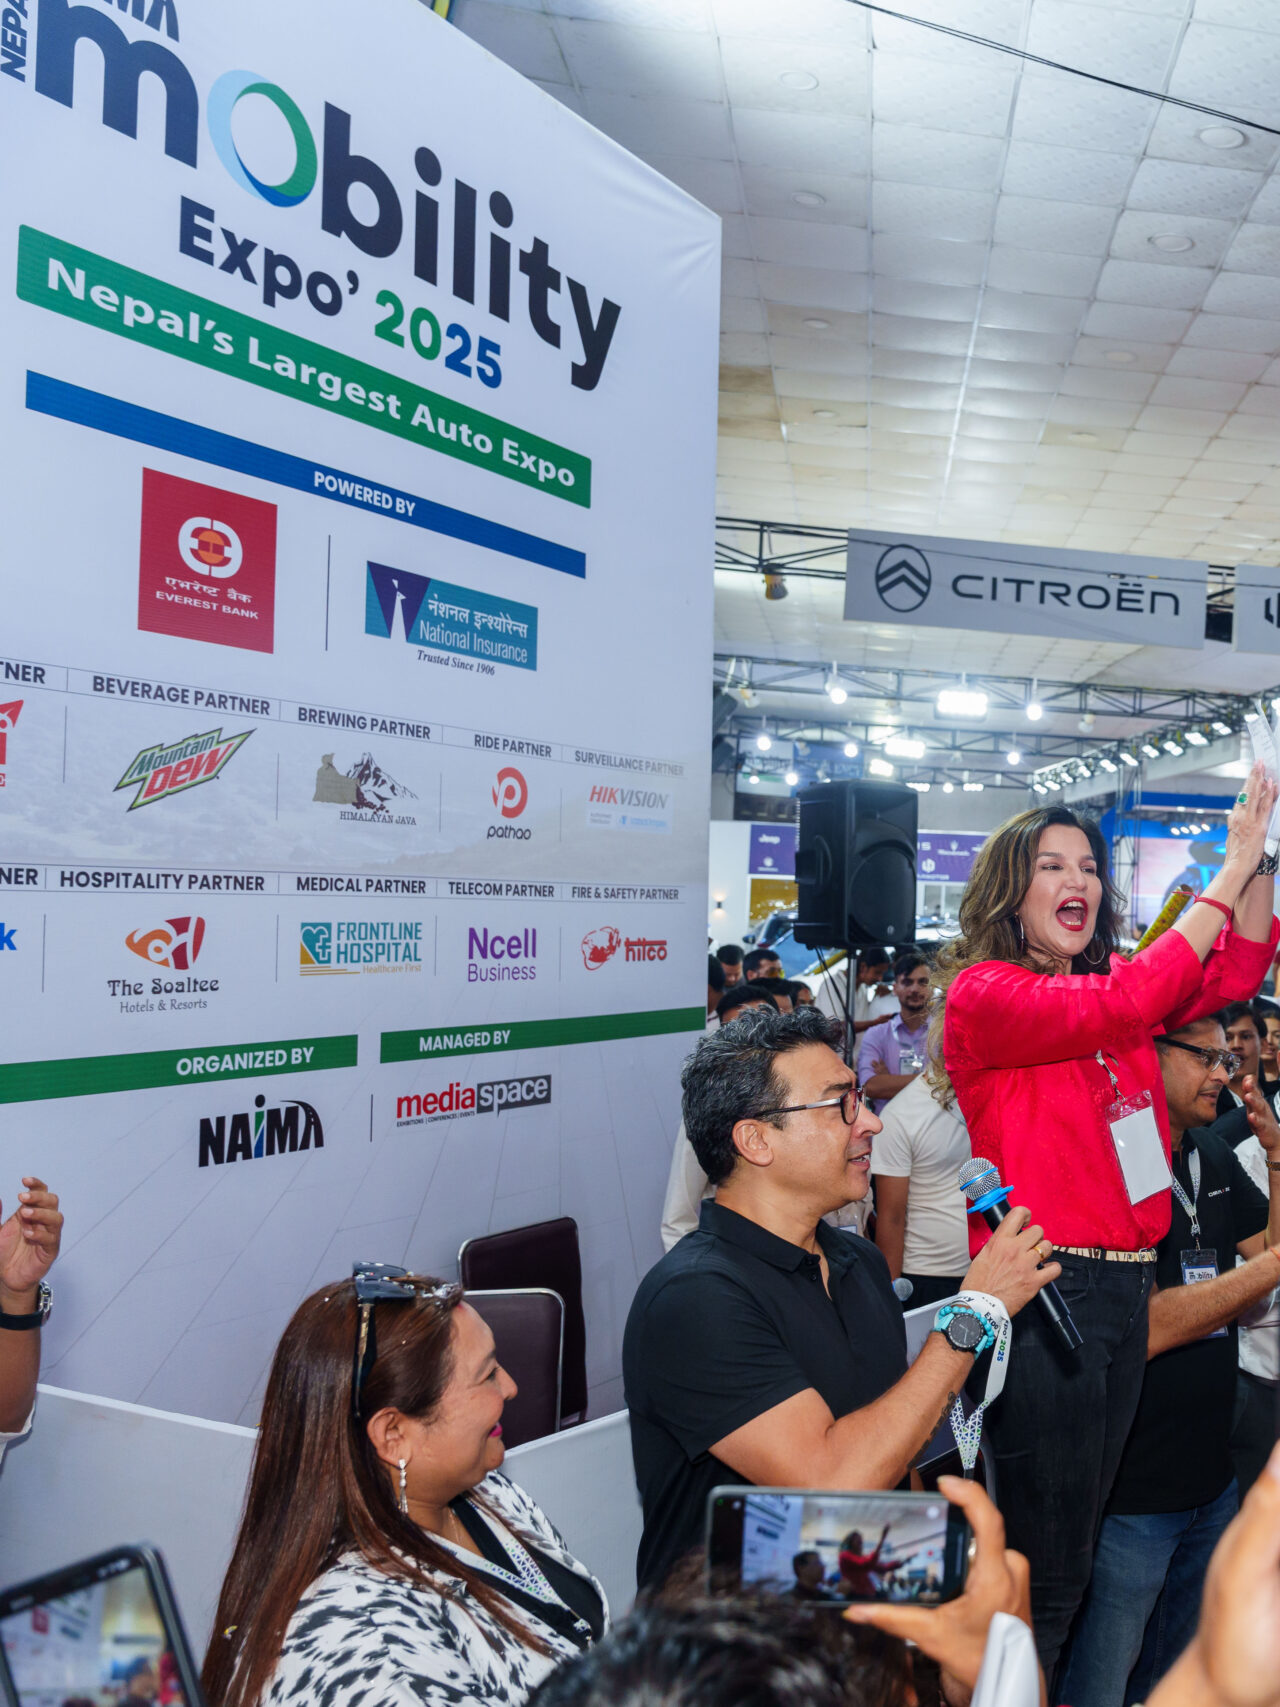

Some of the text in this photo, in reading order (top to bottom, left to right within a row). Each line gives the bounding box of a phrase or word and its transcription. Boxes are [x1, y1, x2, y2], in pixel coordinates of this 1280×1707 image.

[35, 0, 621, 391] mobility
[375, 290, 502, 388] 2025
[248, 336, 401, 420] Largest
[410, 403, 493, 454] Auto
[502, 441, 576, 488] Expo
[313, 471, 416, 517] POWERED BY
[156, 591, 259, 619] EVEREST BANK
[951, 573, 1180, 616] CITROËN
[420, 620, 528, 664] National Insurance
[417, 649, 496, 676] Trusted Since 1906
[93, 675, 270, 715] BEVERAGE PARTNER
[298, 707, 431, 741] BREWING PARTNER
[128, 735, 215, 779] Mountain
[474, 733, 552, 758] RIDE PARTNER
[575, 750, 684, 776] SURVEILLANCE PARTNER
[588, 785, 670, 809] HIKVISION
[339, 811, 417, 826] HIMALAYAN JAVA
[486, 825, 532, 840] pathao
[60, 871, 265, 891] HOSPITALITY PARTNER
[297, 876, 426, 894] MEDICAL PARTNER
[448, 882, 555, 898] TELECOM PARTNER
[572, 886, 679, 900] FIRE & SAFETY PARTNER
[336, 922, 423, 941] FRONTLINE
[468, 927, 537, 960] Ncell
[336, 942, 422, 964] HOSPITAL
[363, 963, 422, 975] Healthcare First
[467, 963, 537, 982] Business
[107, 976, 220, 997] The Soaltee
[119, 998, 208, 1013] Hotels & Resorts
[419, 1029, 511, 1052] MANAGED BY
[176, 1046, 315, 1076] ORGANIZED BY
[396, 1110, 475, 1127] EXHIBITIONS CONFERENCES EVENTS
